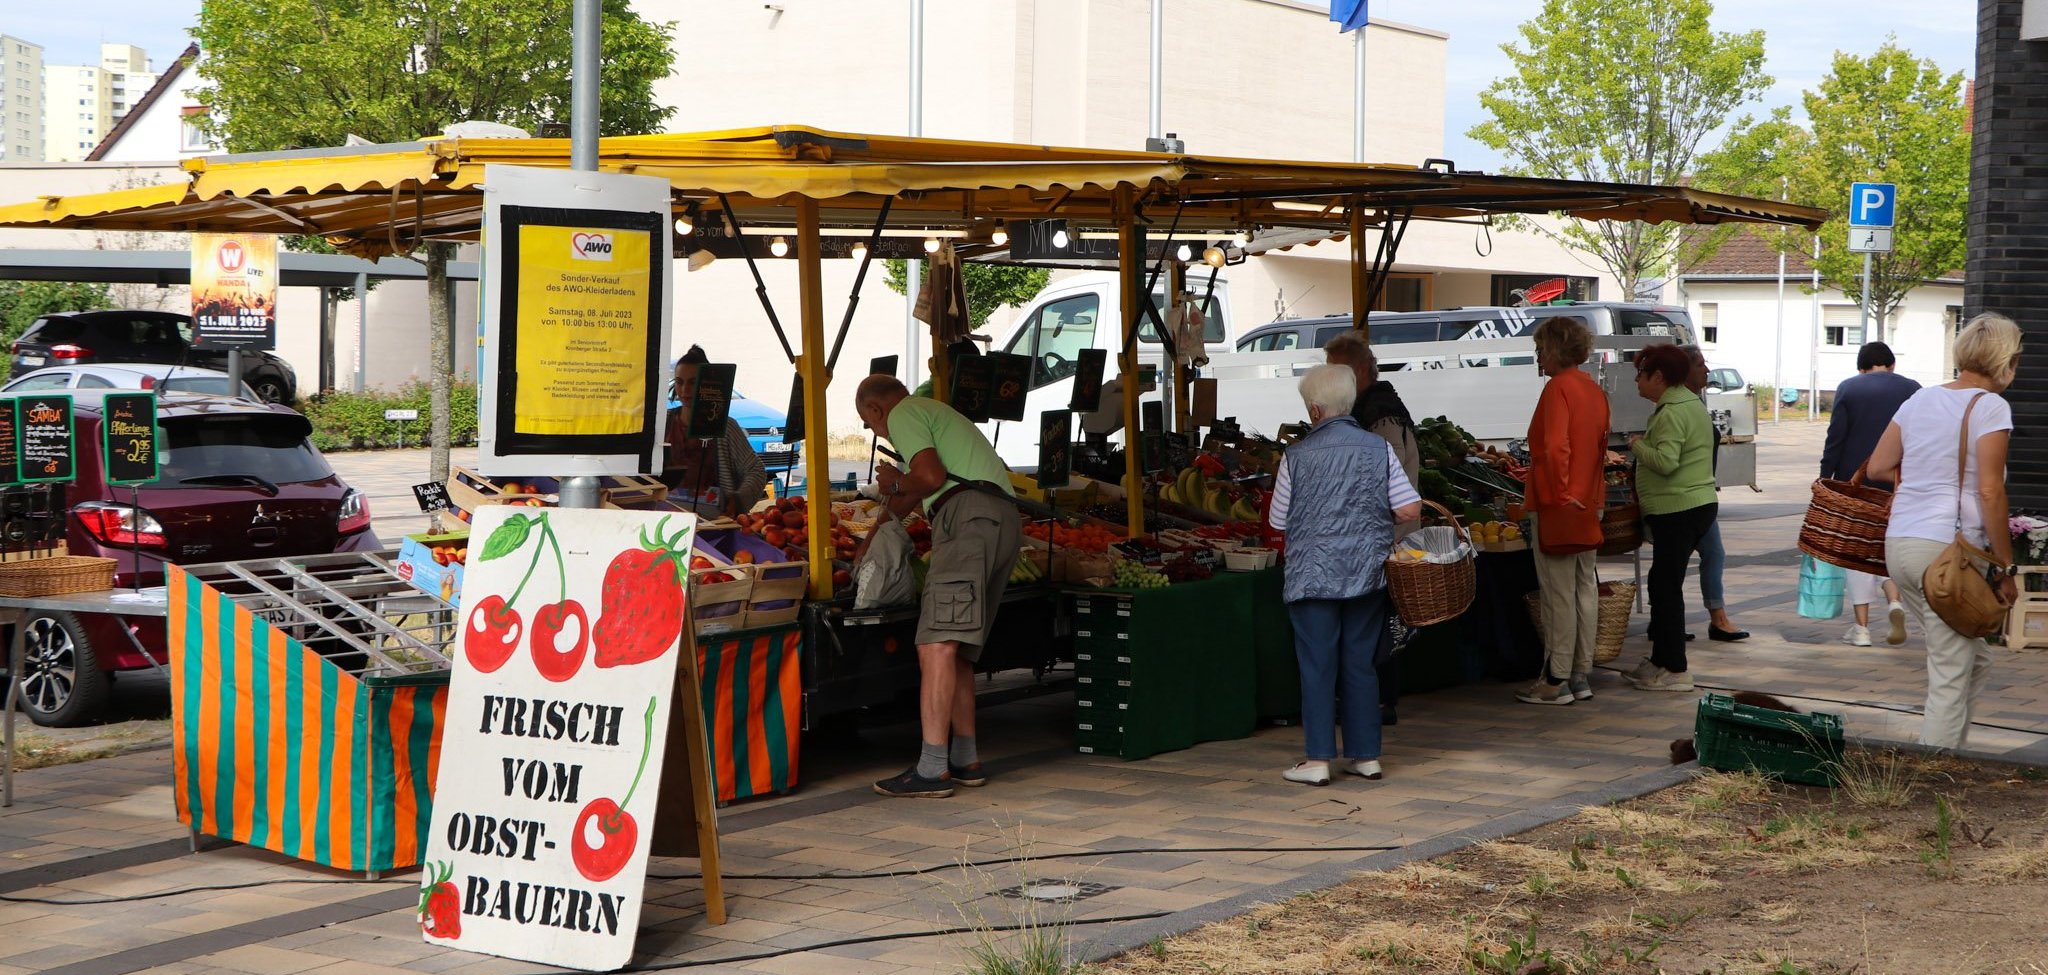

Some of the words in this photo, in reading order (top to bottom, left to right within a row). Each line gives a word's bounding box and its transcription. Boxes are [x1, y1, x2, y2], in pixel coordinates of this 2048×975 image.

[1861, 189, 1885, 220] P
[583, 242, 612, 254] AWO
[220, 248, 241, 268] W
[560, 273, 620, 285] Sonder-Verkauf
[546, 284, 561, 292] des
[563, 284, 636, 296] AWO-Kleiderladens
[548, 307, 586, 318] Samstag,
[587, 309, 598, 317] 08.
[599, 309, 613, 318] Juli
[615, 310, 632, 319] 2023
[217, 315, 237, 326] JULI
[239, 315, 268, 328] 2023
[541, 318, 557, 326] von
[561, 318, 582, 327] 10:00
[584, 319, 595, 327] bis
[597, 320, 617, 328] 13:00
[479, 695, 624, 747] FRISCH
[502, 757, 584, 803] VOM
[447, 812, 556, 861] OBST-
[462, 875, 626, 936] BAUERN
